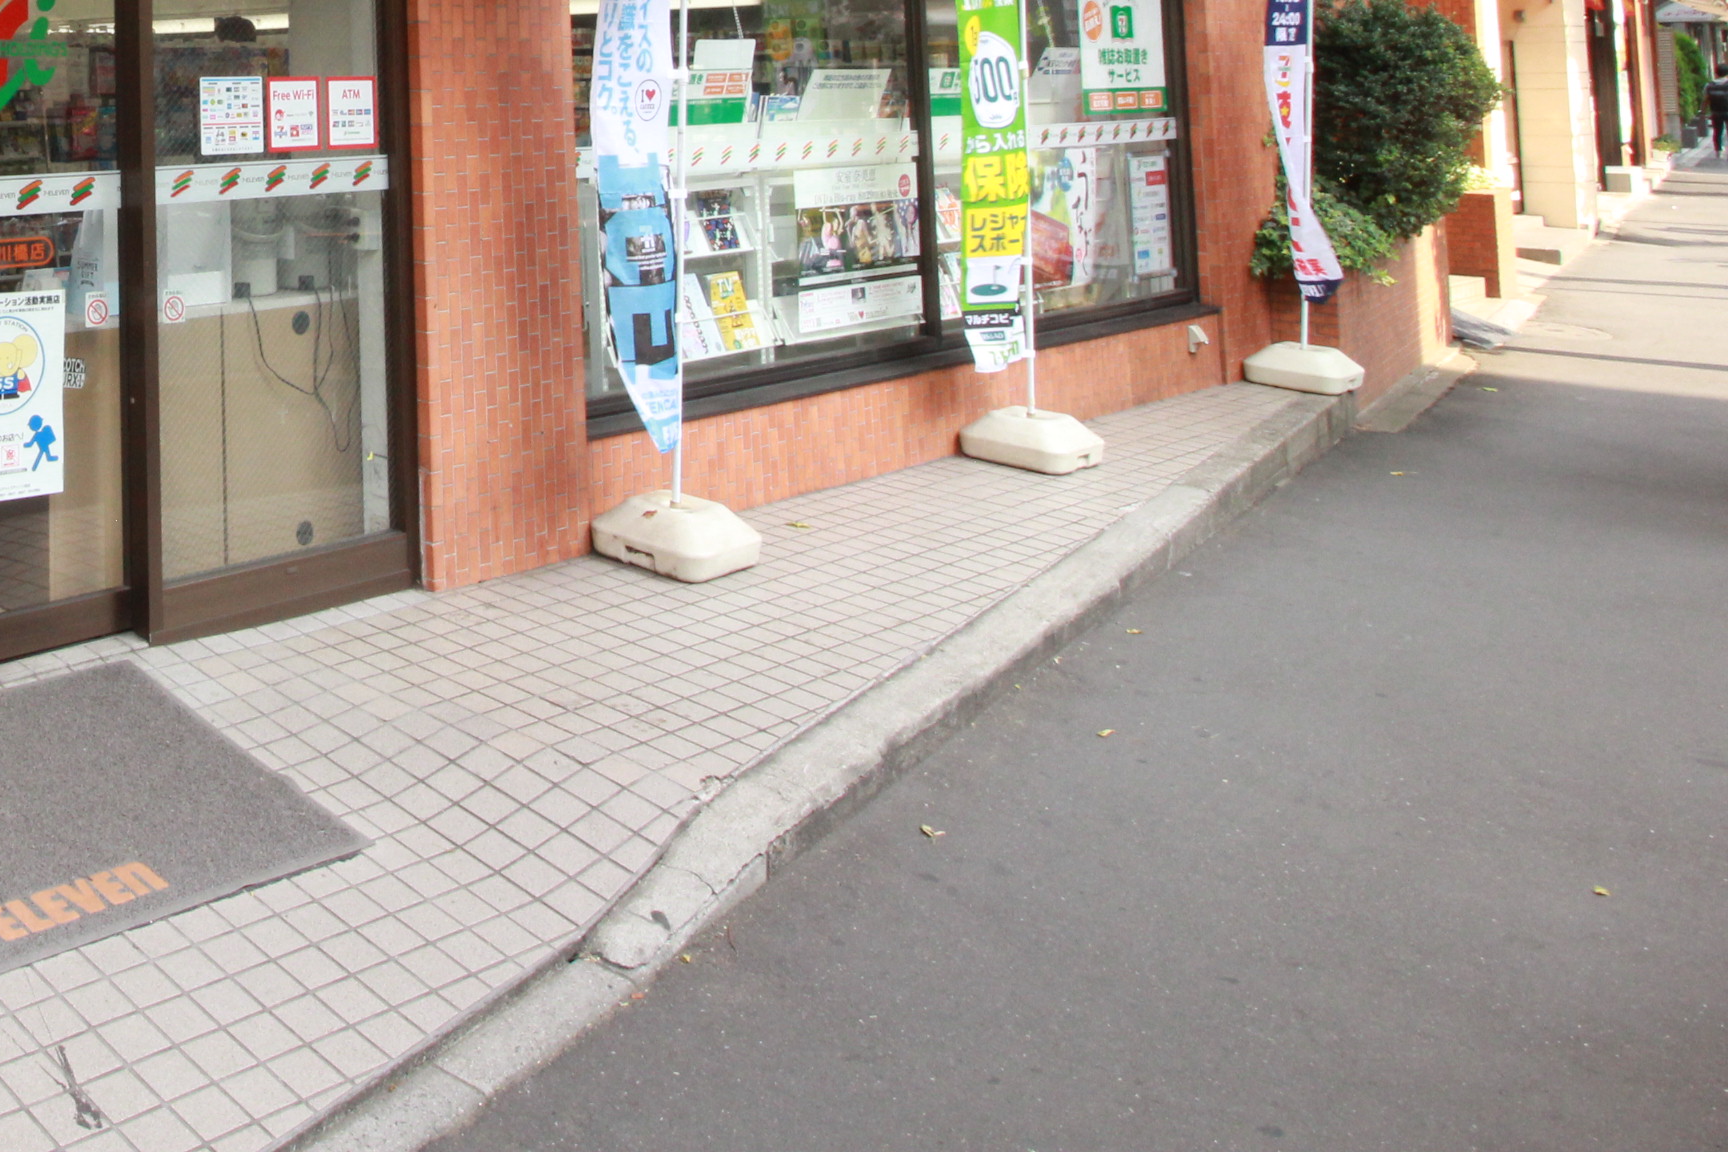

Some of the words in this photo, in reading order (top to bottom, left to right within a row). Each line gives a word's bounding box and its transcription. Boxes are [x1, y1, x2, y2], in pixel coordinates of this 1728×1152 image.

[1272, 12, 1301, 26] 24:00
[1108, 68, 1141, 83] サービス
[272, 90, 291, 101] Free
[292, 89, 314, 100] Wi-Fi
[341, 89, 361, 99] ATM
[965, 151, 1031, 203] 保険
[969, 233, 1025, 253] スポー
